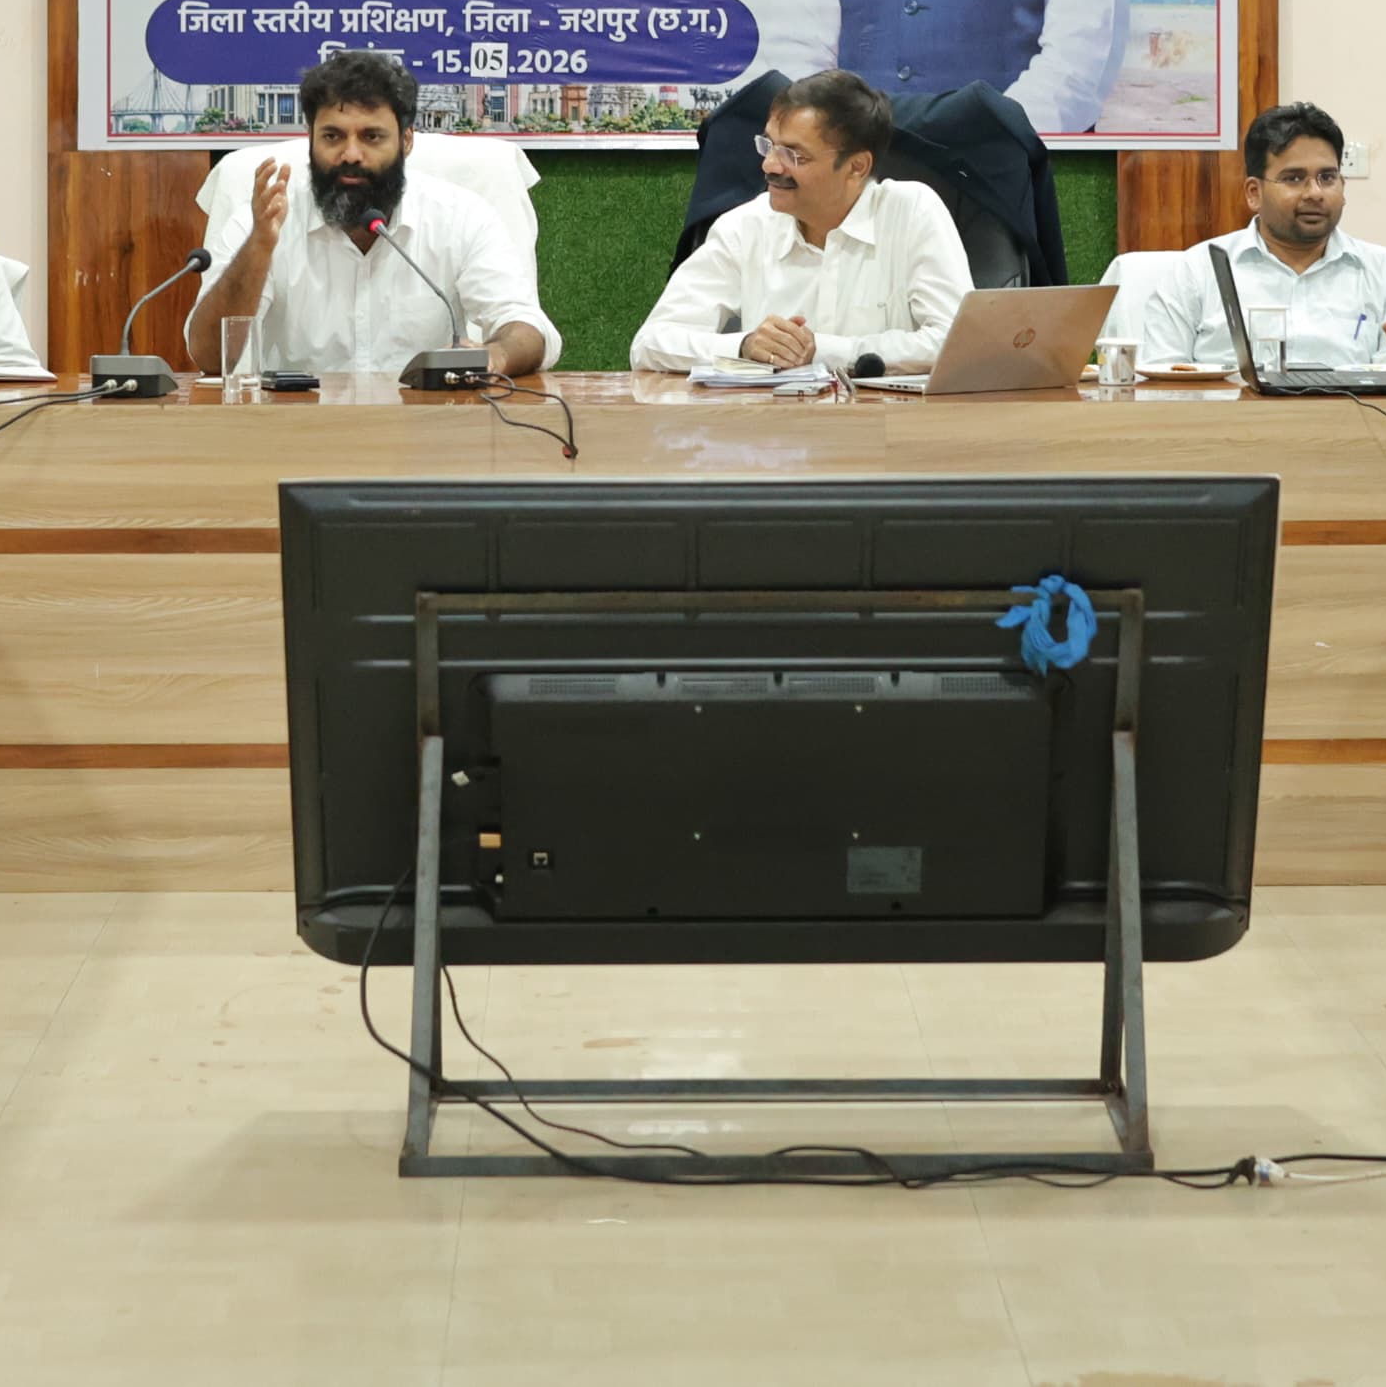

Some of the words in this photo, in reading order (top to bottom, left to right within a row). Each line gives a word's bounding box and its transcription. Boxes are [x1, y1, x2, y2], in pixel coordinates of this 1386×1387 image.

[177, 1, 247, 32] जिला
[252, 1, 333, 32] स्तरीय
[339, 1, 454, 37] प्रशिक्षण,
[462, 1, 532, 33] जिला
[558, 8, 640, 42] जशपुर
[647, 8, 728, 39] (छ.ग.)
[431, 47, 588, 74] 15.05.2026
